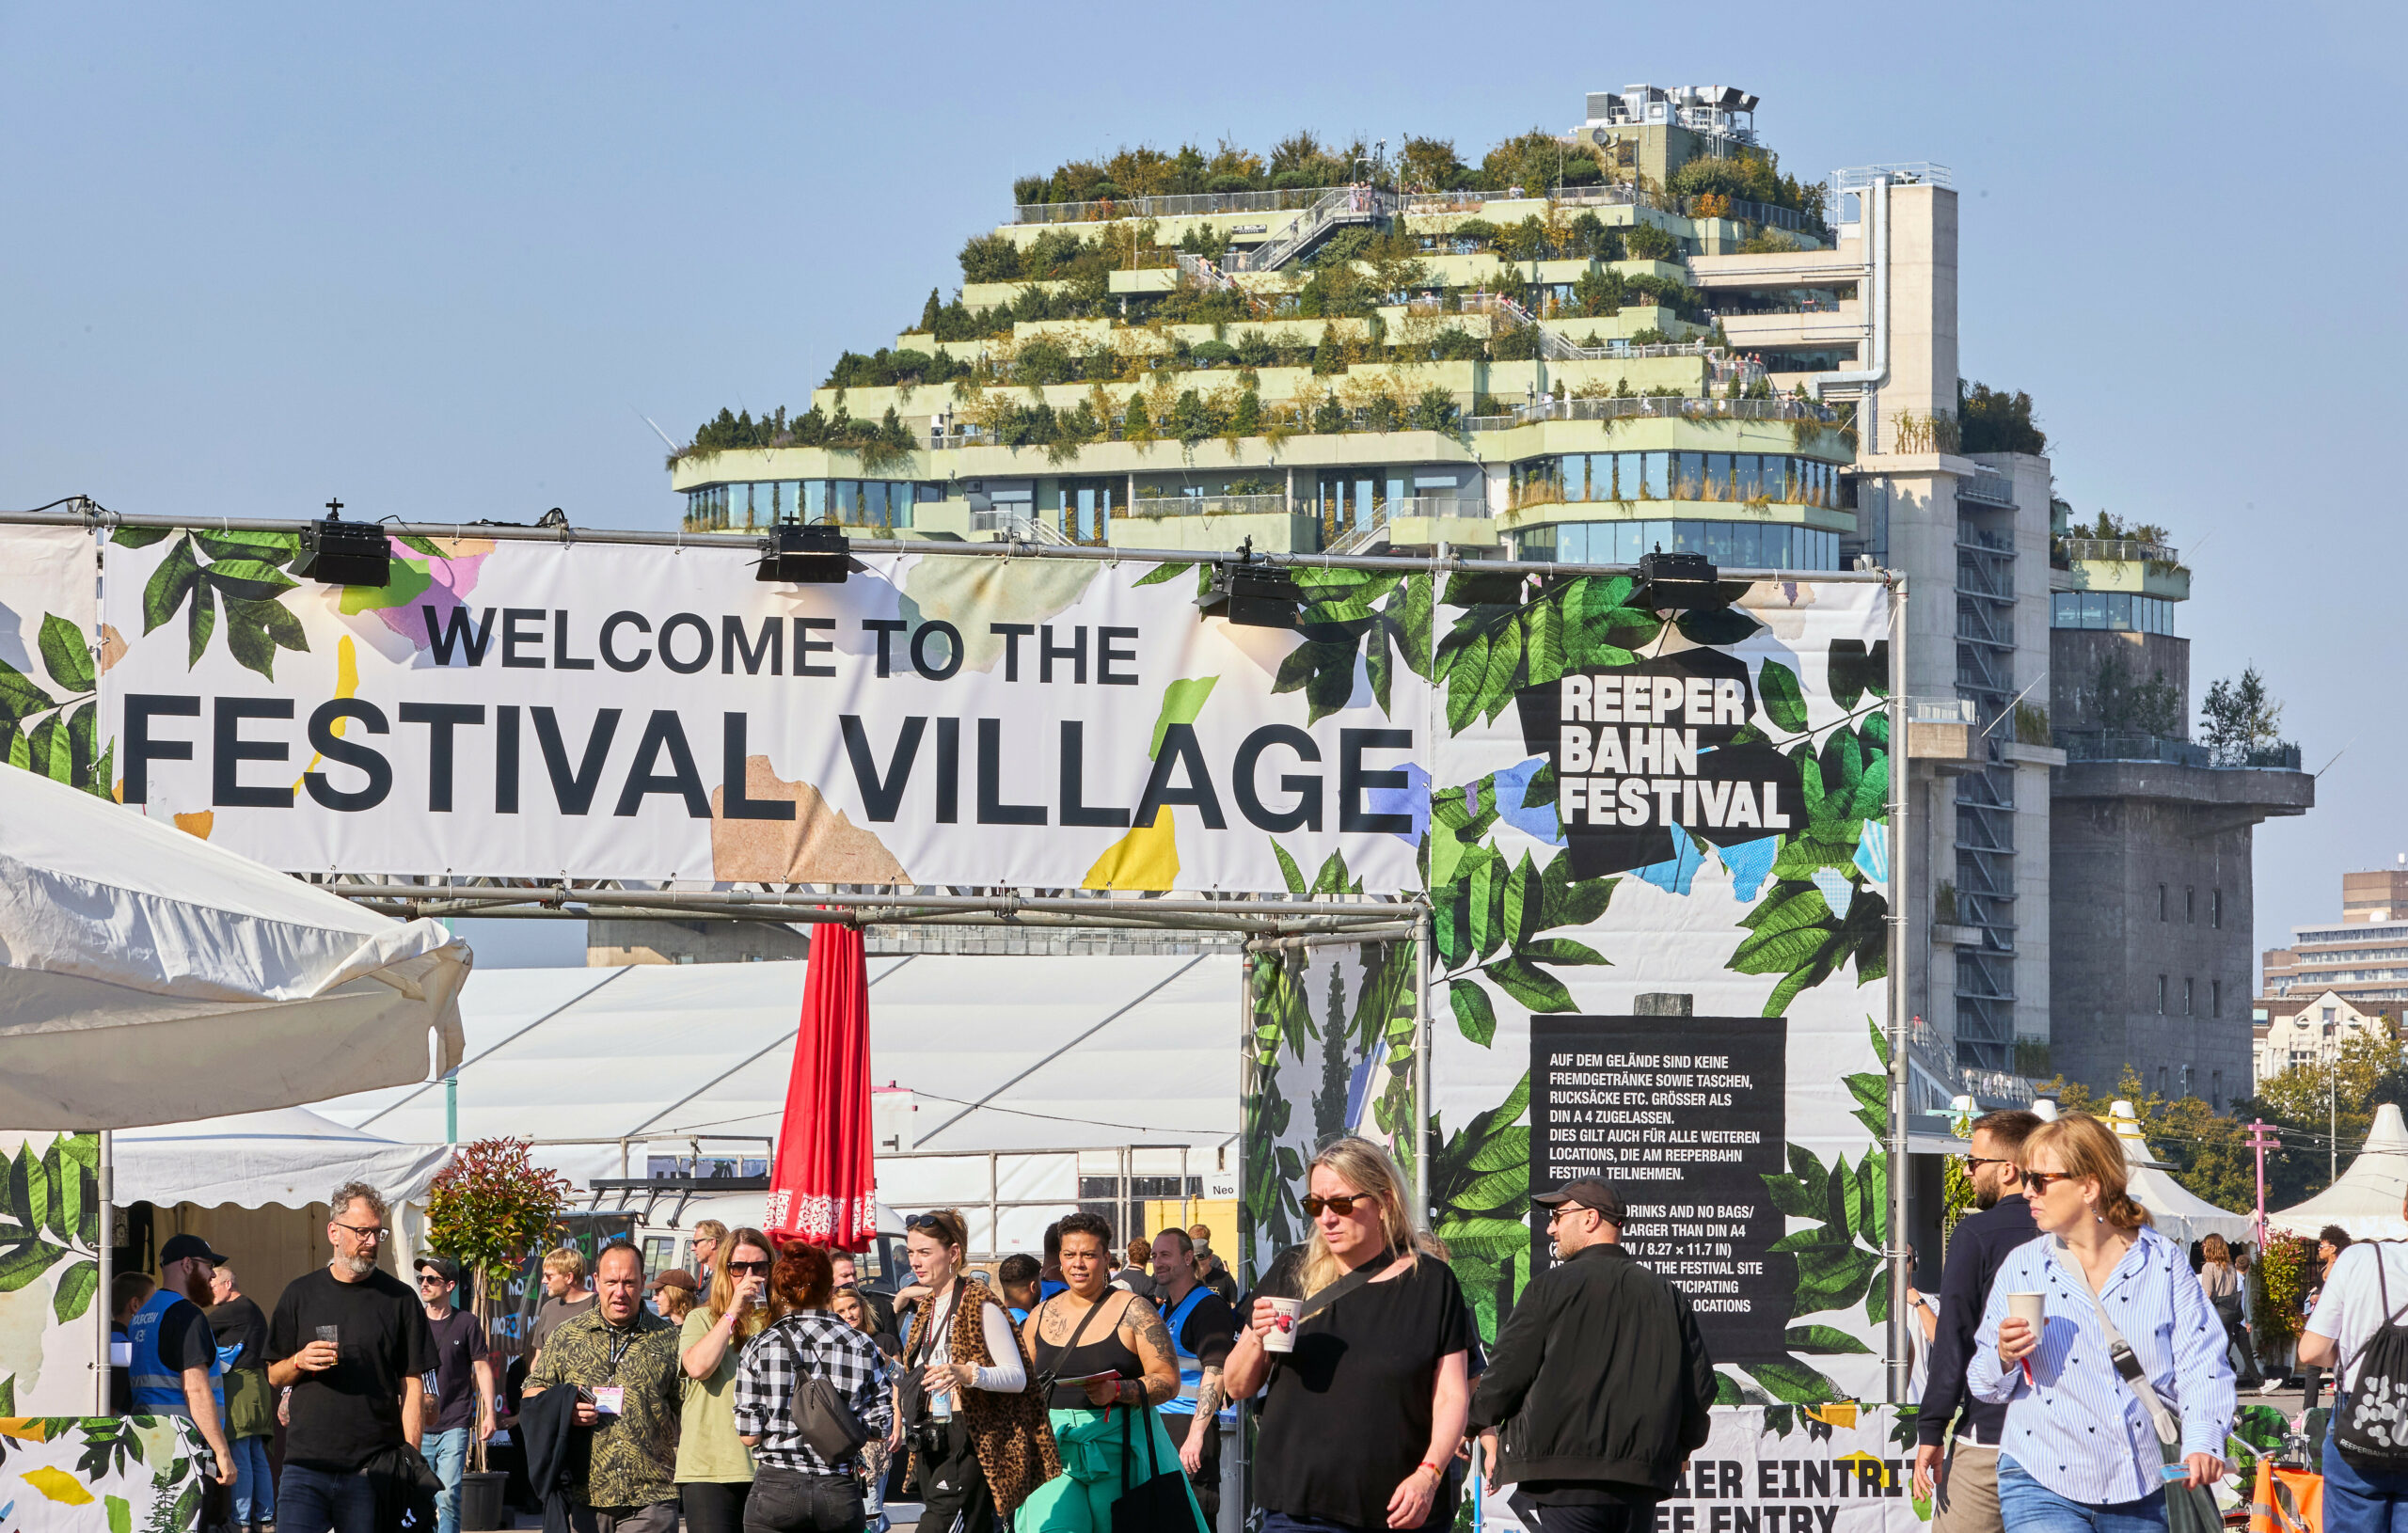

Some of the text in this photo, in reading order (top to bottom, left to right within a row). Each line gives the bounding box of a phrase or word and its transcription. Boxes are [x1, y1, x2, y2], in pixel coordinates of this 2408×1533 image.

[421, 605, 1139, 686] WELCOME TO THE
[1560, 674, 1746, 726] REEPER
[1560, 725, 1698, 776] BAHN
[121, 693, 1413, 834] FESTIVAL VILLAGE
[1559, 777, 1791, 830] FESTIVAL
[1549, 1051, 1729, 1069] AUF DEM GELÄNDE SIND KEINE
[1549, 1071, 1753, 1089] FREMDGETRÄNKE SOWIE TASCHEN,
[1549, 1090, 1733, 1106] RUCKSÄCKE ETC. GRÖSSER ALS
[1549, 1110, 1675, 1124] DIN A 4 ZUGELASSEN.
[1549, 1128, 1761, 1145] DIES GILT AUCH FÜR ALLE WEITEREN
[1549, 1147, 1743, 1164] LOCATIONS, DIE AM REEPERBAHN
[1607, 1166, 1685, 1180] TEILNEHMEN.
[1212, 1185, 1234, 1195] Neo
[1669, 1205, 1695, 1219] AND
[1697, 1206, 1715, 1219] NO
[1718, 1205, 1755, 1219] BAGS/
[1622, 1224, 1747, 1238] LARGER THAN DIN A4
[1646, 1242, 1672, 1256] 8.27
[1687, 1242, 1713, 1256] 11.7
[1715, 1242, 1733, 1259] IN)
[1655, 1261, 1678, 1274] THE
[1680, 1261, 1735, 1275] FESTIVAL
[1736, 1261, 1764, 1275] SITE
[1693, 1299, 1751, 1313] OCATIONS
[2339, 1438, 2389, 1458] REEPERBAHN
[1673, 1460, 1744, 1499] IER
